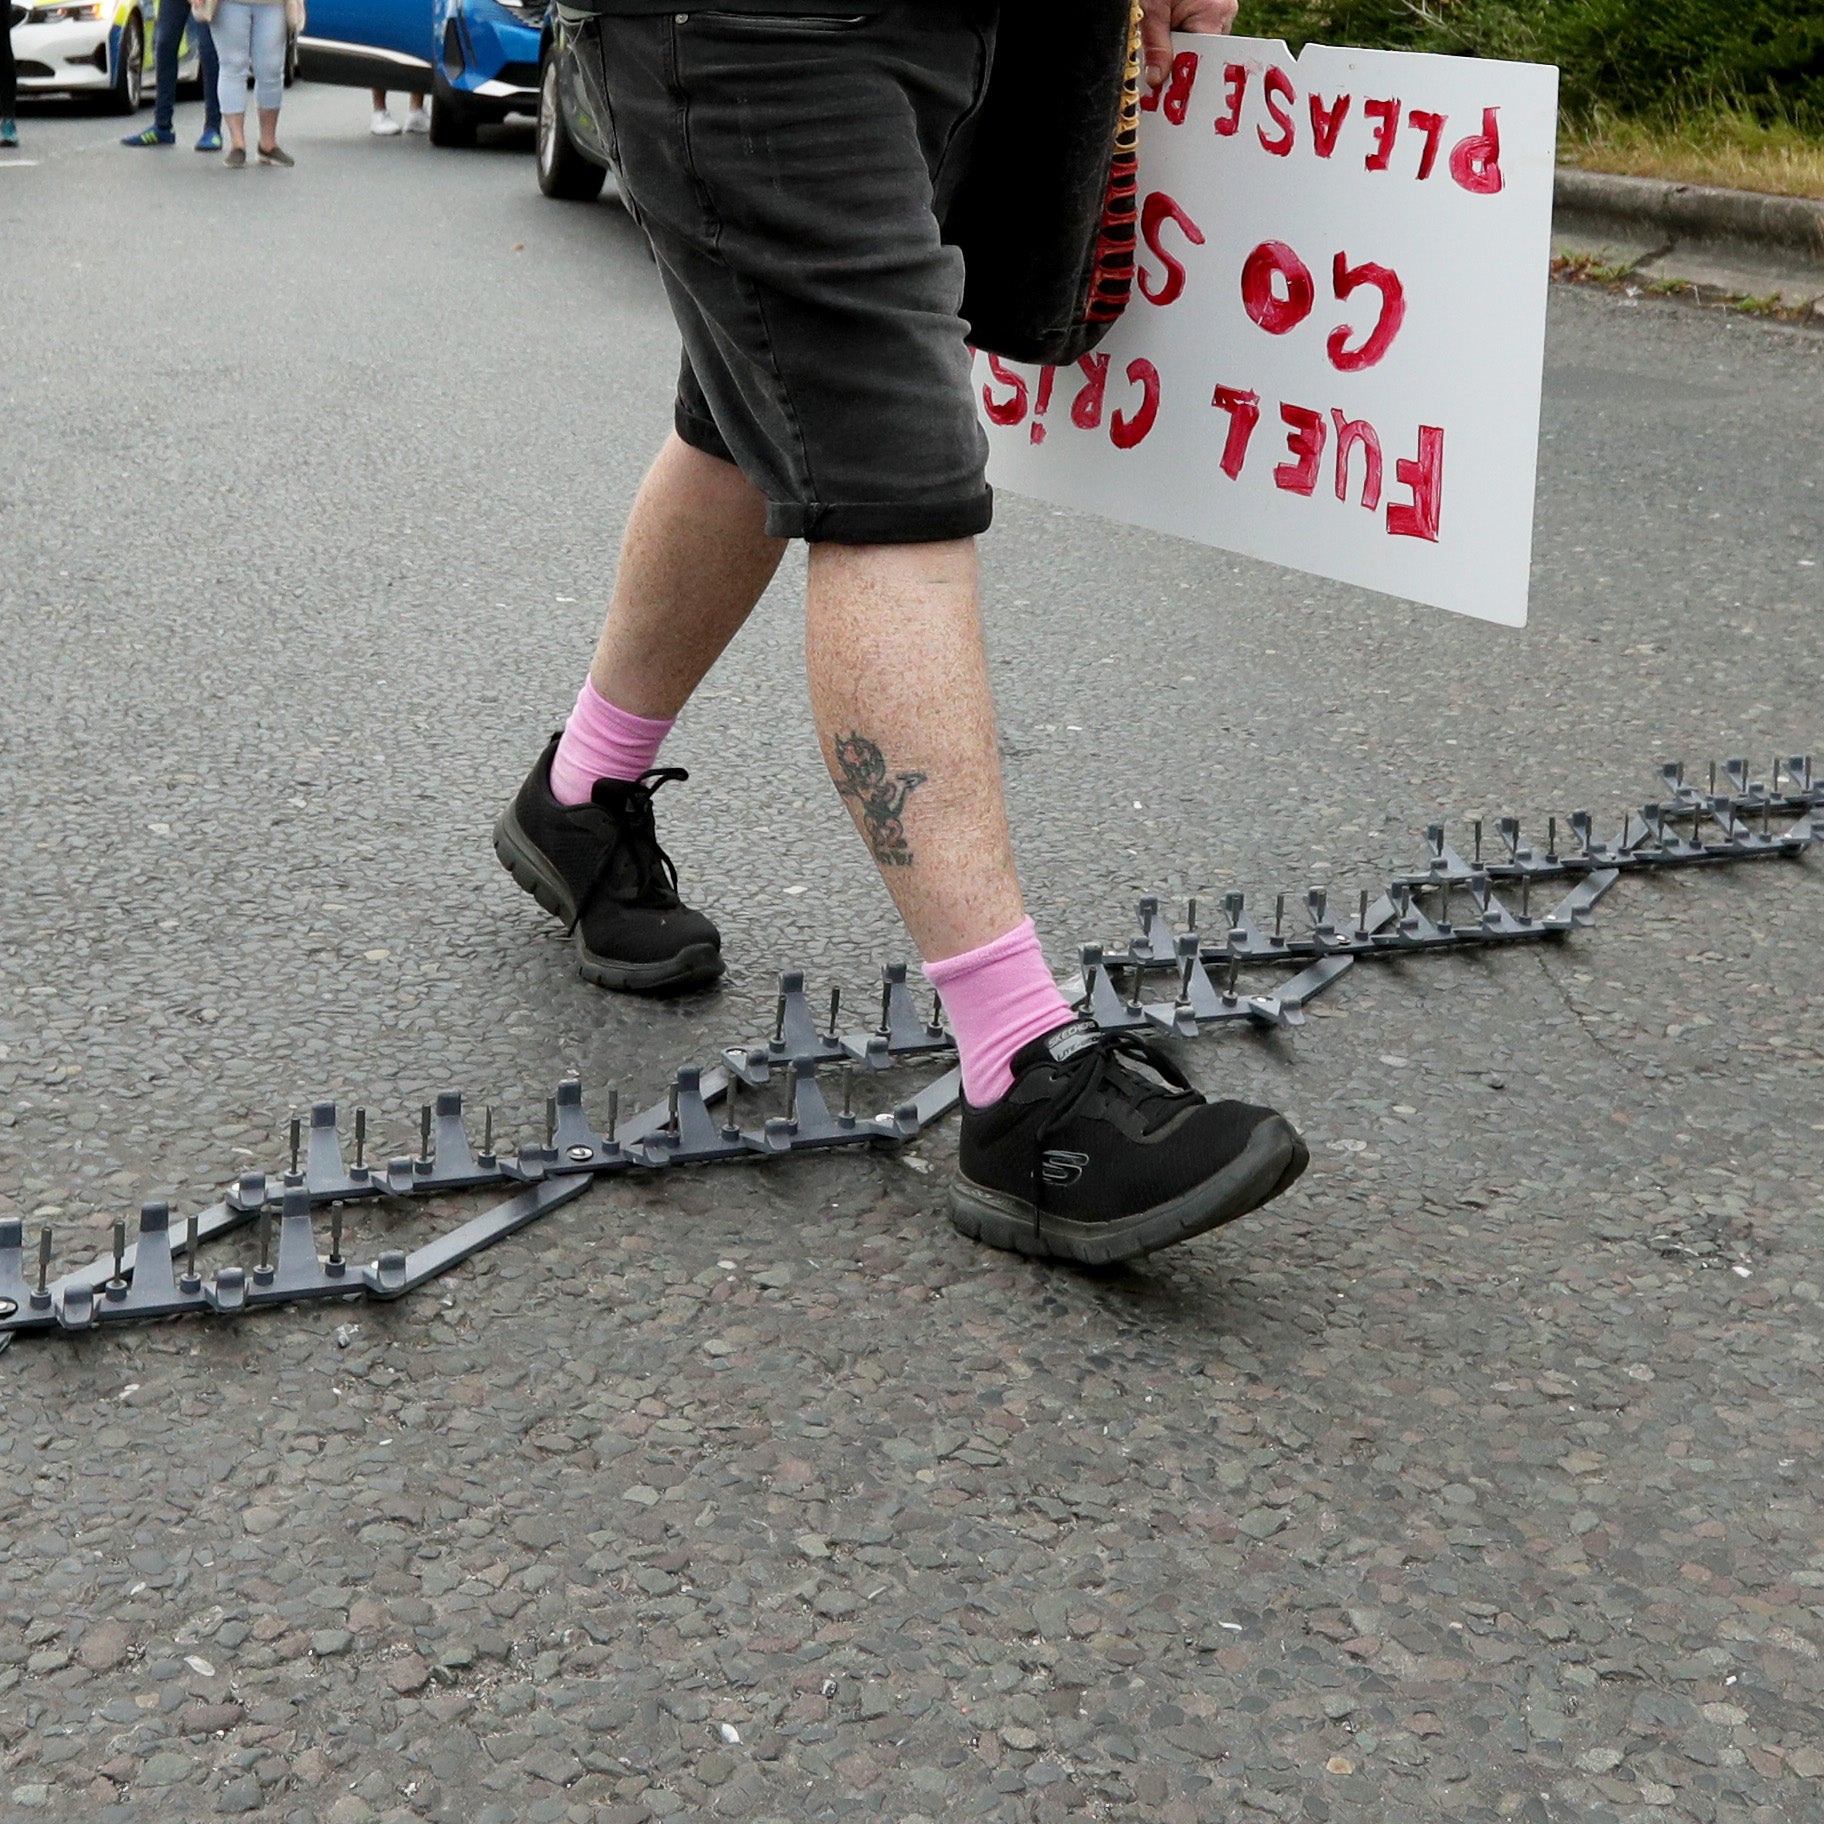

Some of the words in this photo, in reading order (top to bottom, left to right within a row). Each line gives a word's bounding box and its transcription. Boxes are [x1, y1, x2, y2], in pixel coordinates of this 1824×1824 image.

[1215, 65, 1503, 195] PLEASE
[1243, 241, 1407, 372] GO
[1213, 385, 1444, 543] FUEL
